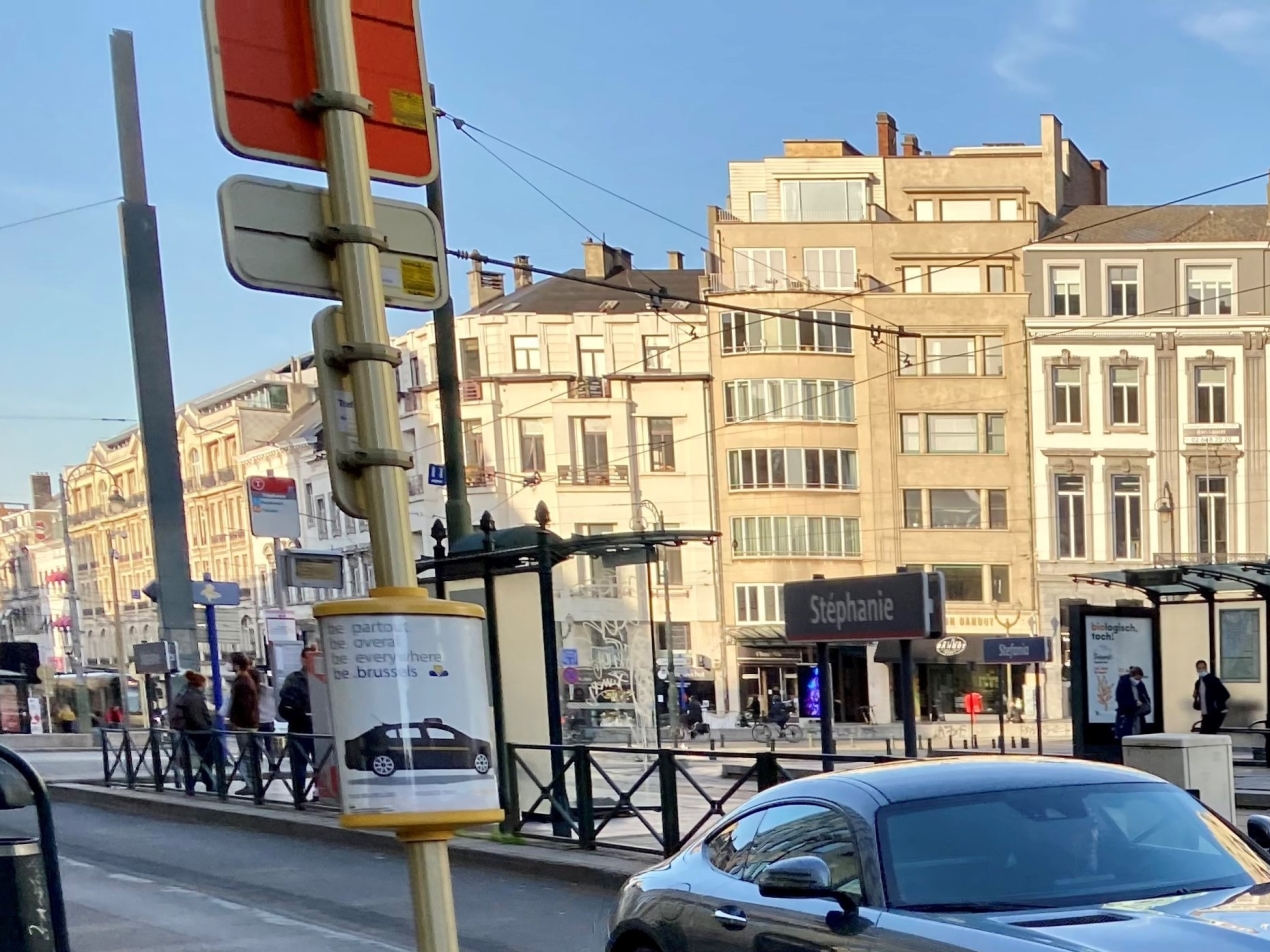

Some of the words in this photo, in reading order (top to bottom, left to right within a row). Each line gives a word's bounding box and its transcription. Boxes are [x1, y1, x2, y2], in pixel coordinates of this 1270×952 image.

[810, 590, 894, 631] Stéphanie
[330, 637, 347, 649] be
[332, 652, 349, 665] be
[334, 668, 350, 679] be
